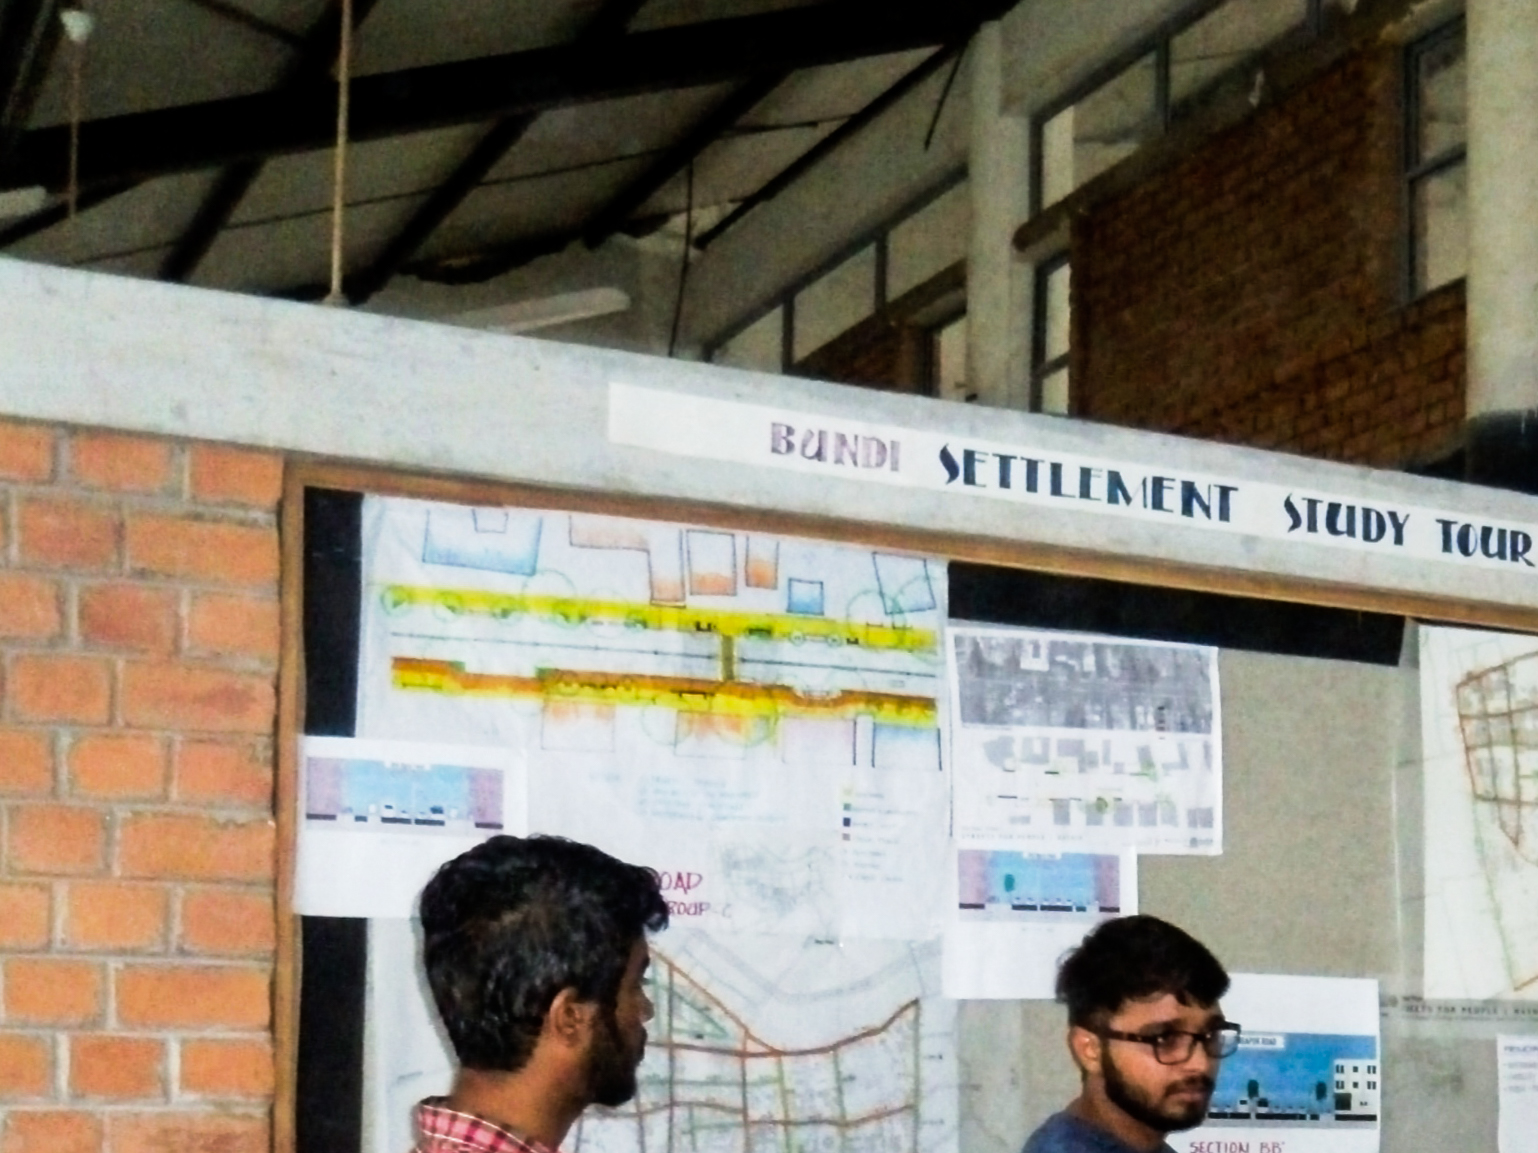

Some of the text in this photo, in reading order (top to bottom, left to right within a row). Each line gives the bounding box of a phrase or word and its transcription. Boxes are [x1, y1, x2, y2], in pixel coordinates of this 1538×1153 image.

[771, 422, 899, 472] BUNDI
[939, 443, 1239, 522] SETTLEMENT
[1284, 493, 1410, 546] STUDY
[1435, 519, 1535, 567] TOUR
[659, 871, 703, 895] OAD
